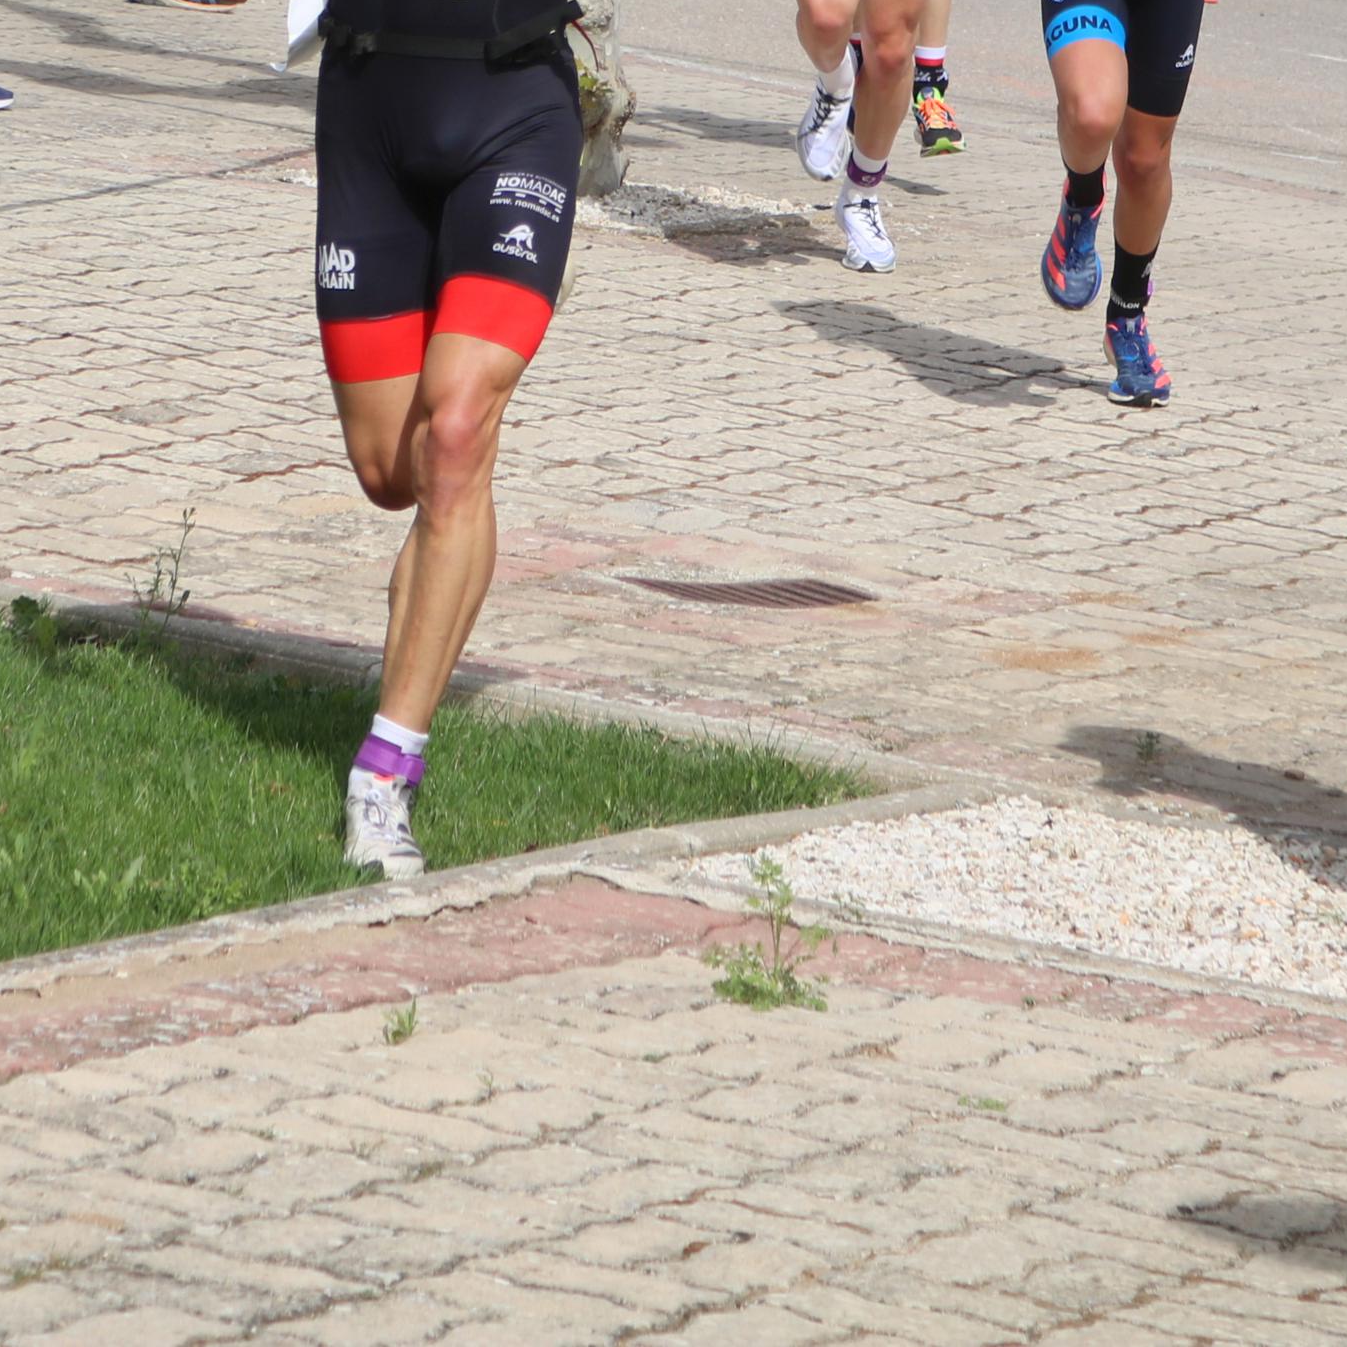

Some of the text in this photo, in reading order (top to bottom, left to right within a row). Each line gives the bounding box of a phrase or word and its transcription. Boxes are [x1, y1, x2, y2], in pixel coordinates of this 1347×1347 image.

[495, 177, 566, 204] NOMADAC
[318, 242, 355, 273] MAD
[492, 242, 538, 264] austral
